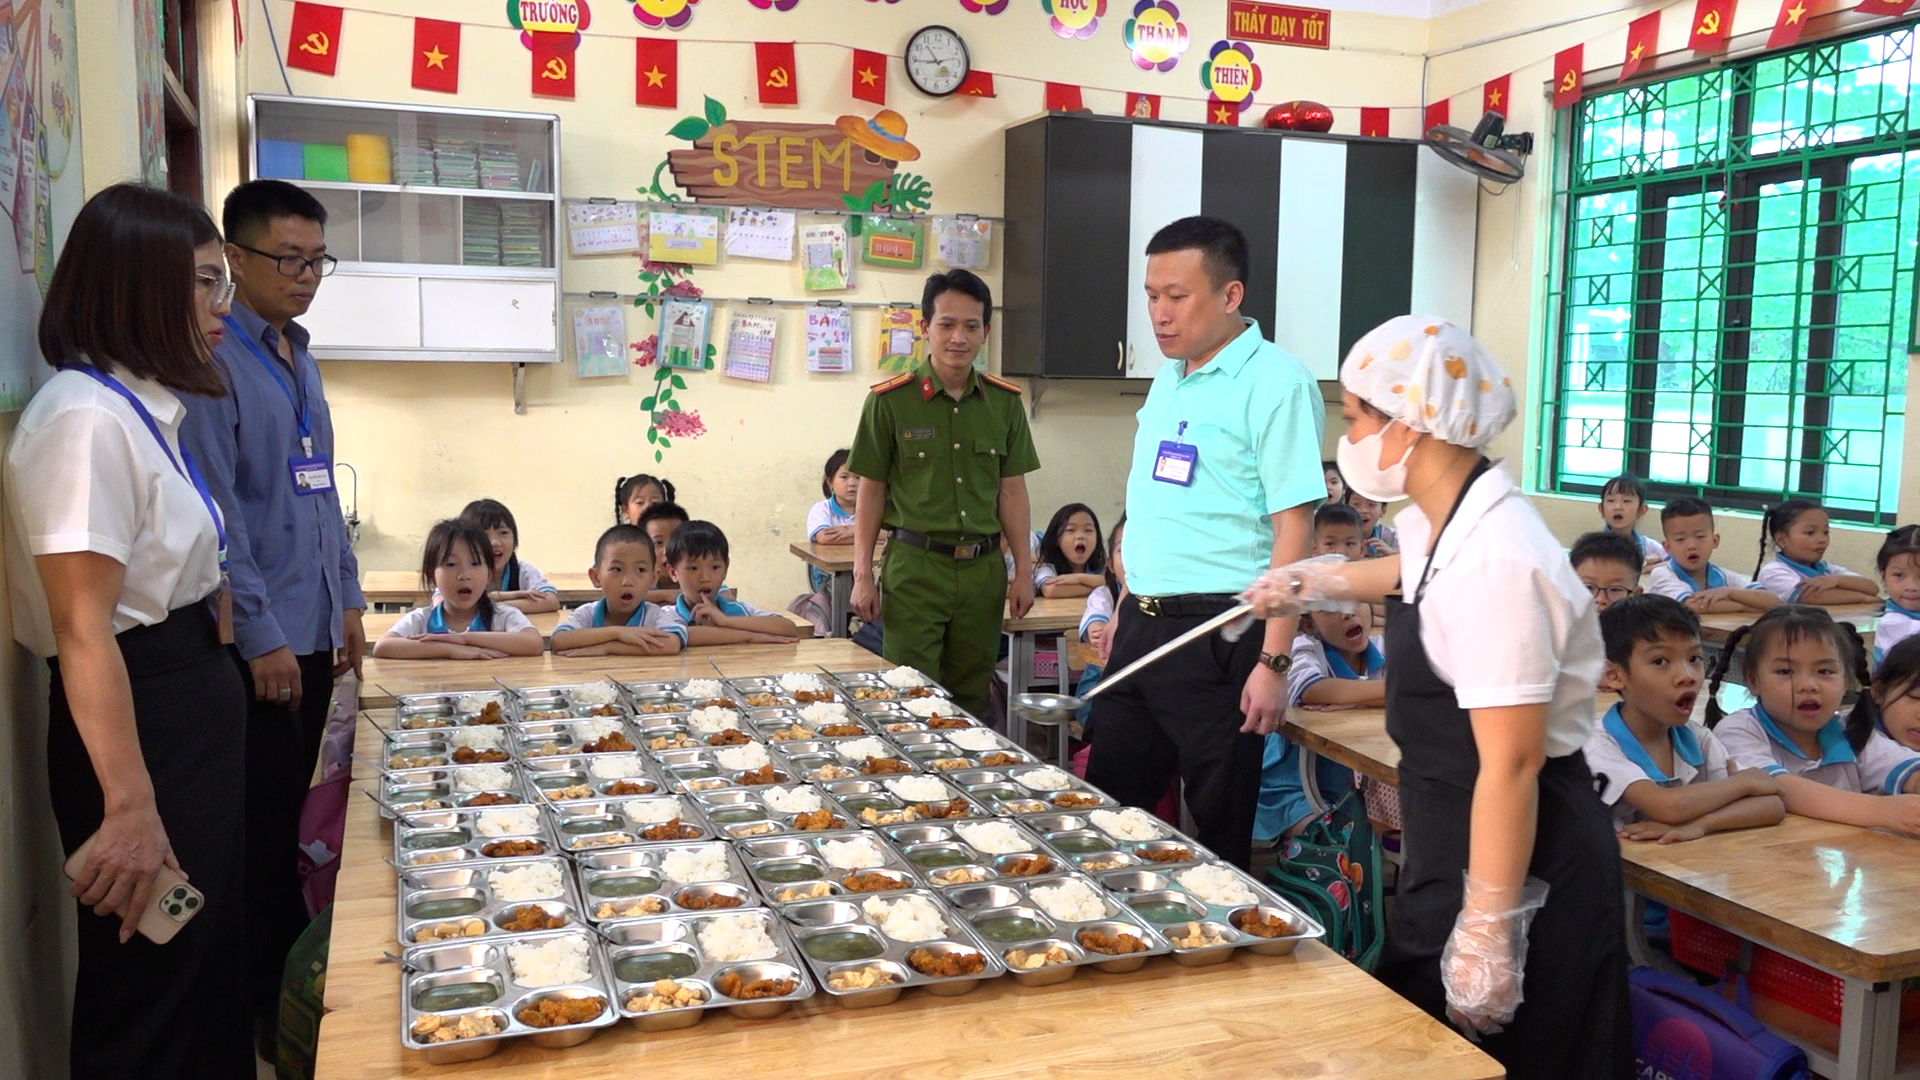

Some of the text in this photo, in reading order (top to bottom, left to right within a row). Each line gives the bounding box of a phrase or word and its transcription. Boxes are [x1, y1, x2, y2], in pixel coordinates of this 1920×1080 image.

[1137, 21, 1175, 42] THÂN
[1271, 15, 1296, 41] DẠY
[1302, 13, 1325, 41] TỐT
[1214, 63, 1249, 90] THIỆN
[713, 134, 851, 191] STEM
